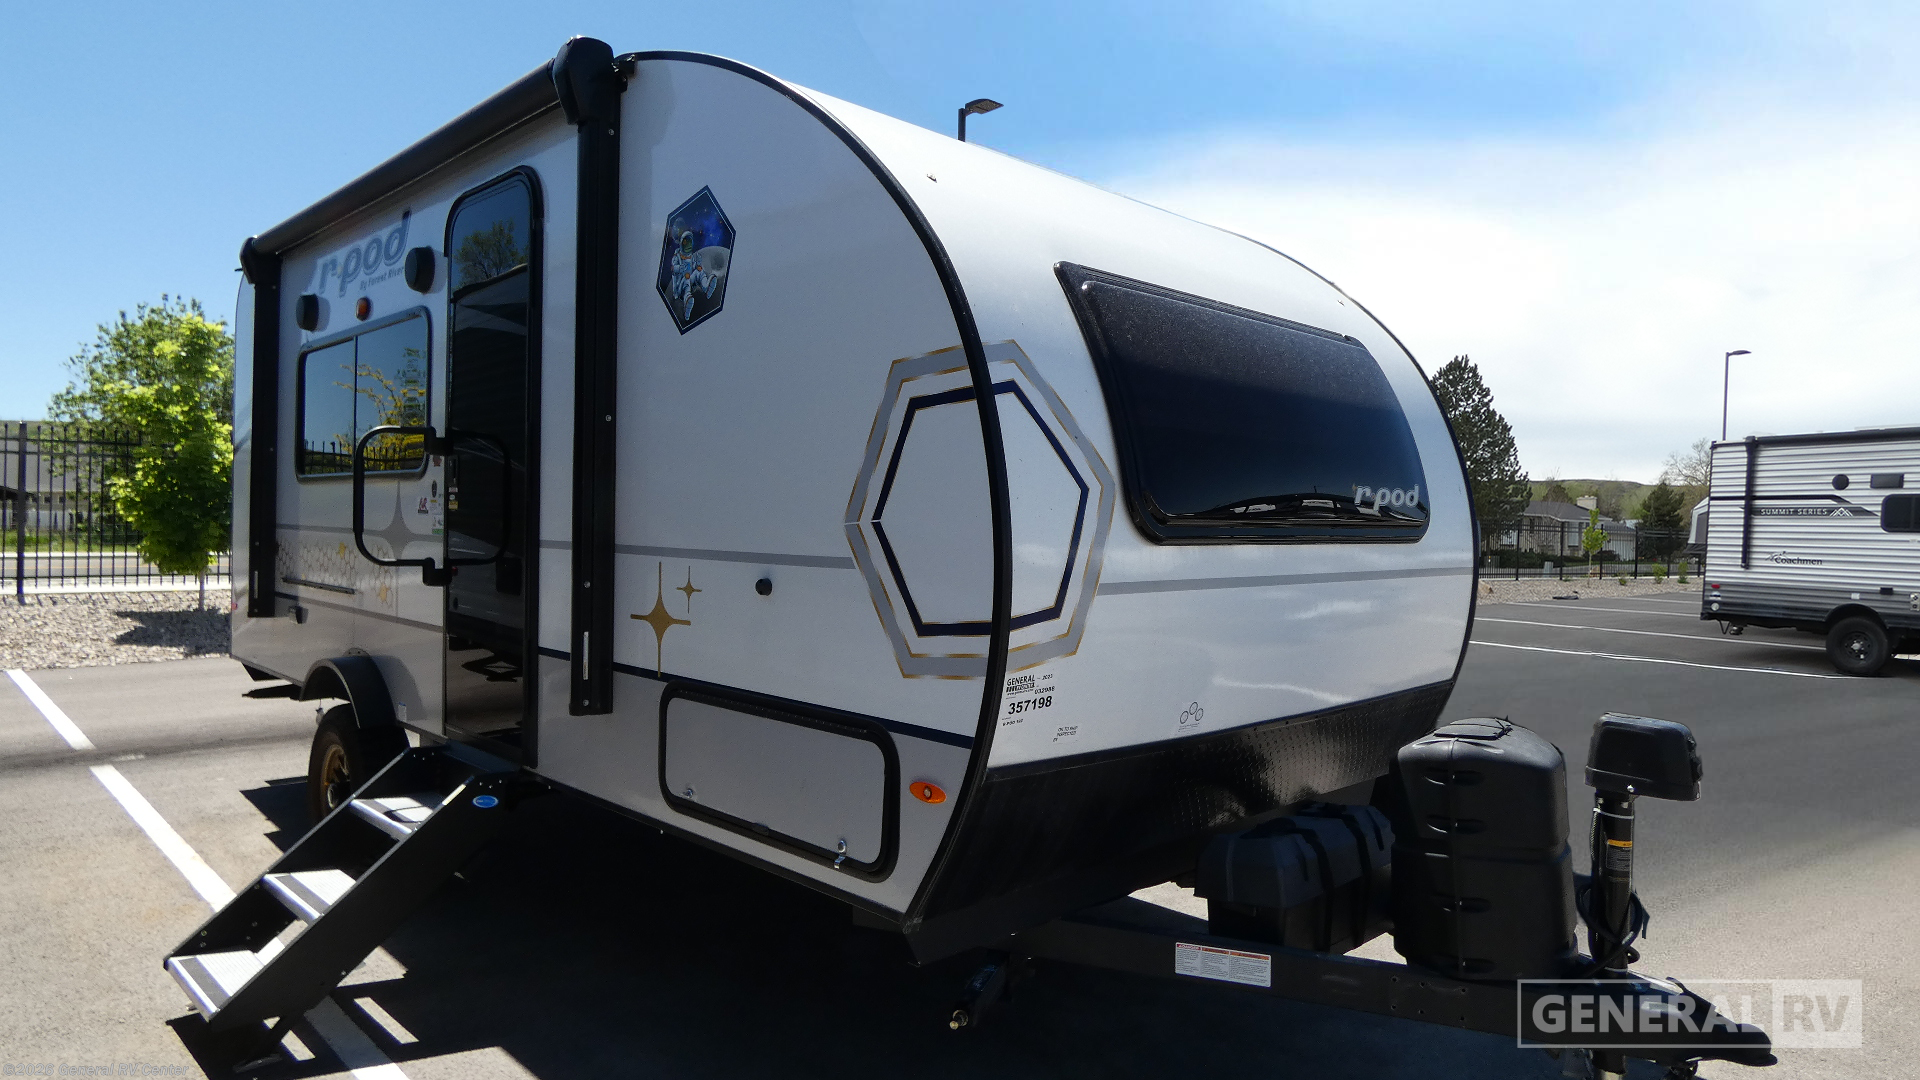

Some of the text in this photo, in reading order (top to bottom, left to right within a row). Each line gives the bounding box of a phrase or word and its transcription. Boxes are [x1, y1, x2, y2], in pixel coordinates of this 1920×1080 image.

[1760, 508, 1828, 516] SUMMIT SERIES
[1774, 556, 1823, 566] Coachmen
[1006, 674, 1035, 686] GENERAL
[1008, 695, 1053, 715] 357198
